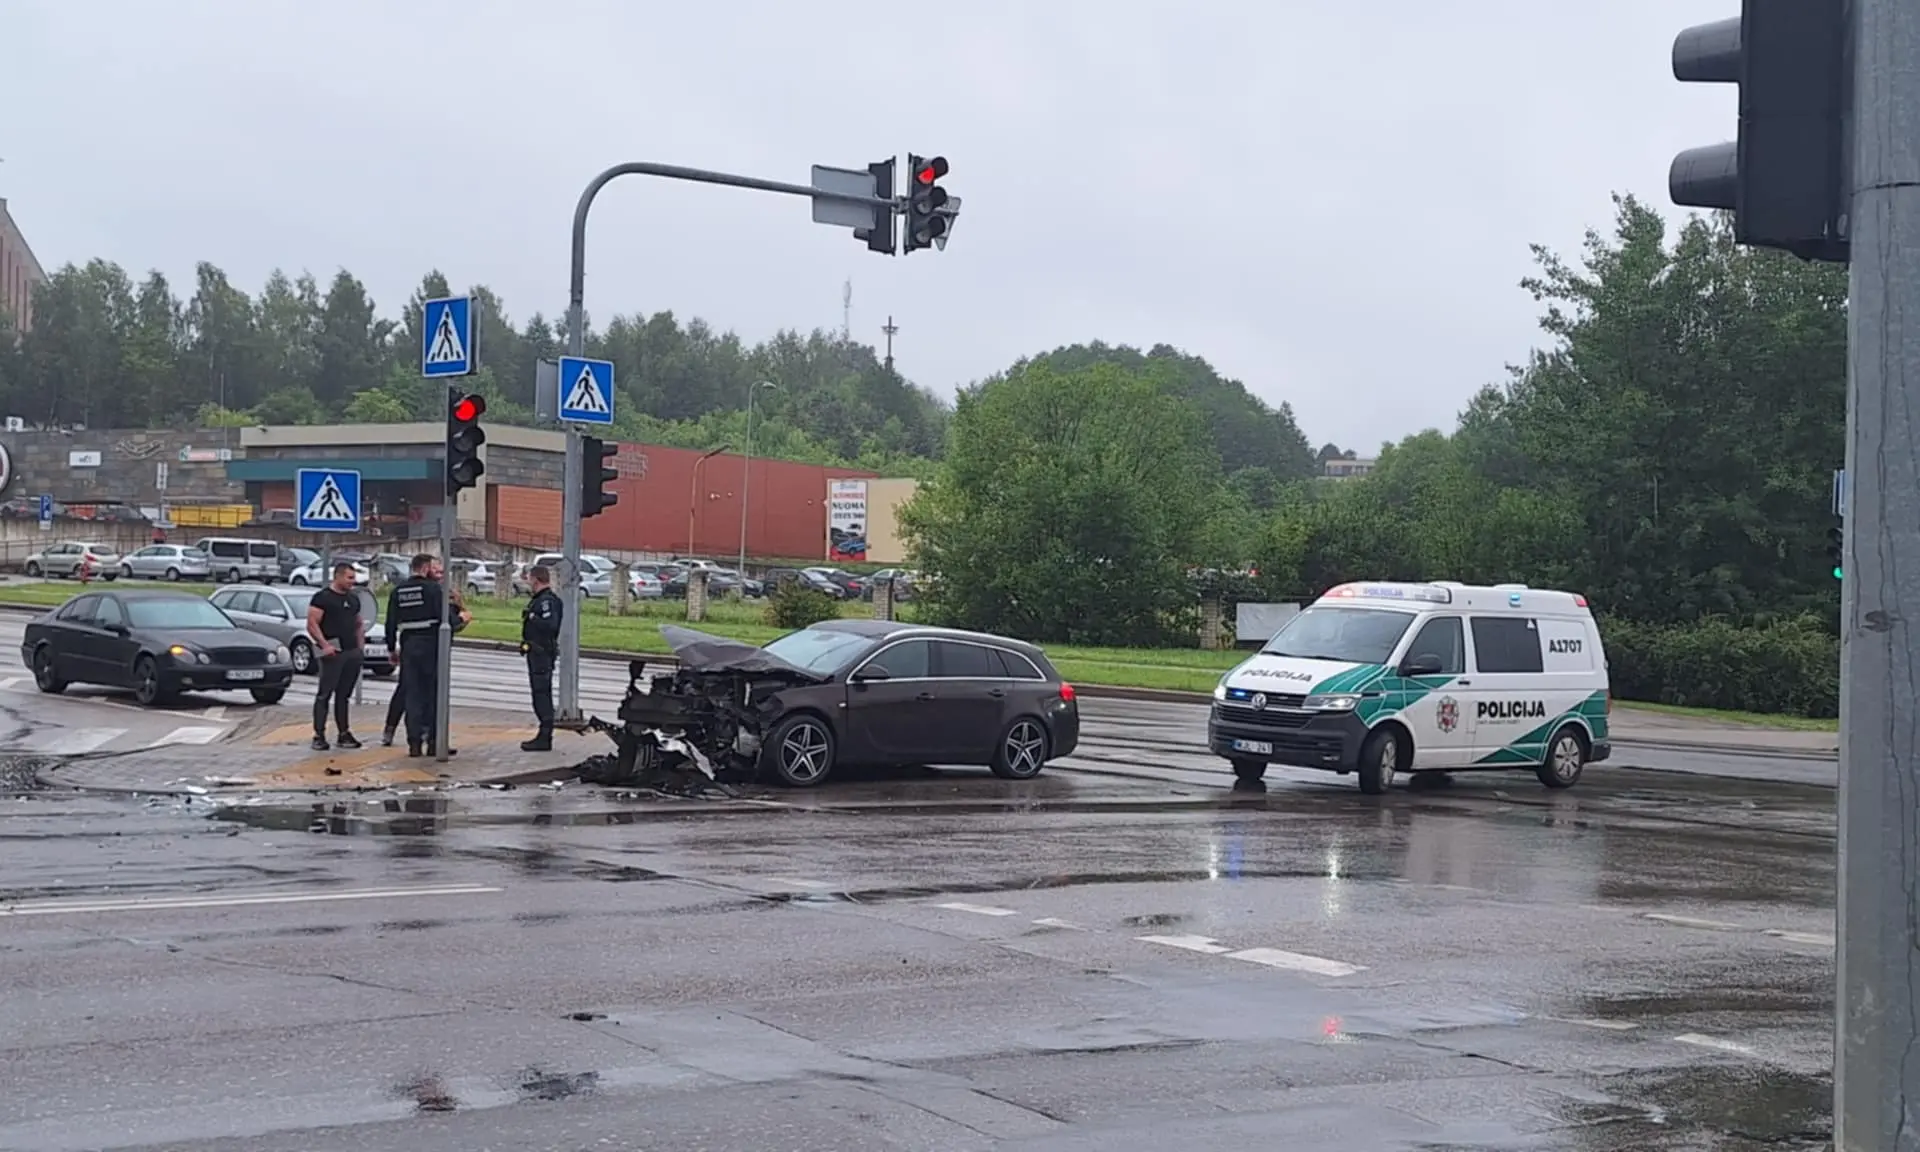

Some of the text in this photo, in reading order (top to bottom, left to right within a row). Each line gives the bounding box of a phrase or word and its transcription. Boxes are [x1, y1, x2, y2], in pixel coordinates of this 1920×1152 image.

[832, 502, 865, 510] NUOMA
[1549, 639, 1582, 653] A1707
[1241, 669, 1313, 682] POLICIJA
[1477, 701, 1546, 718] POLICIJA
